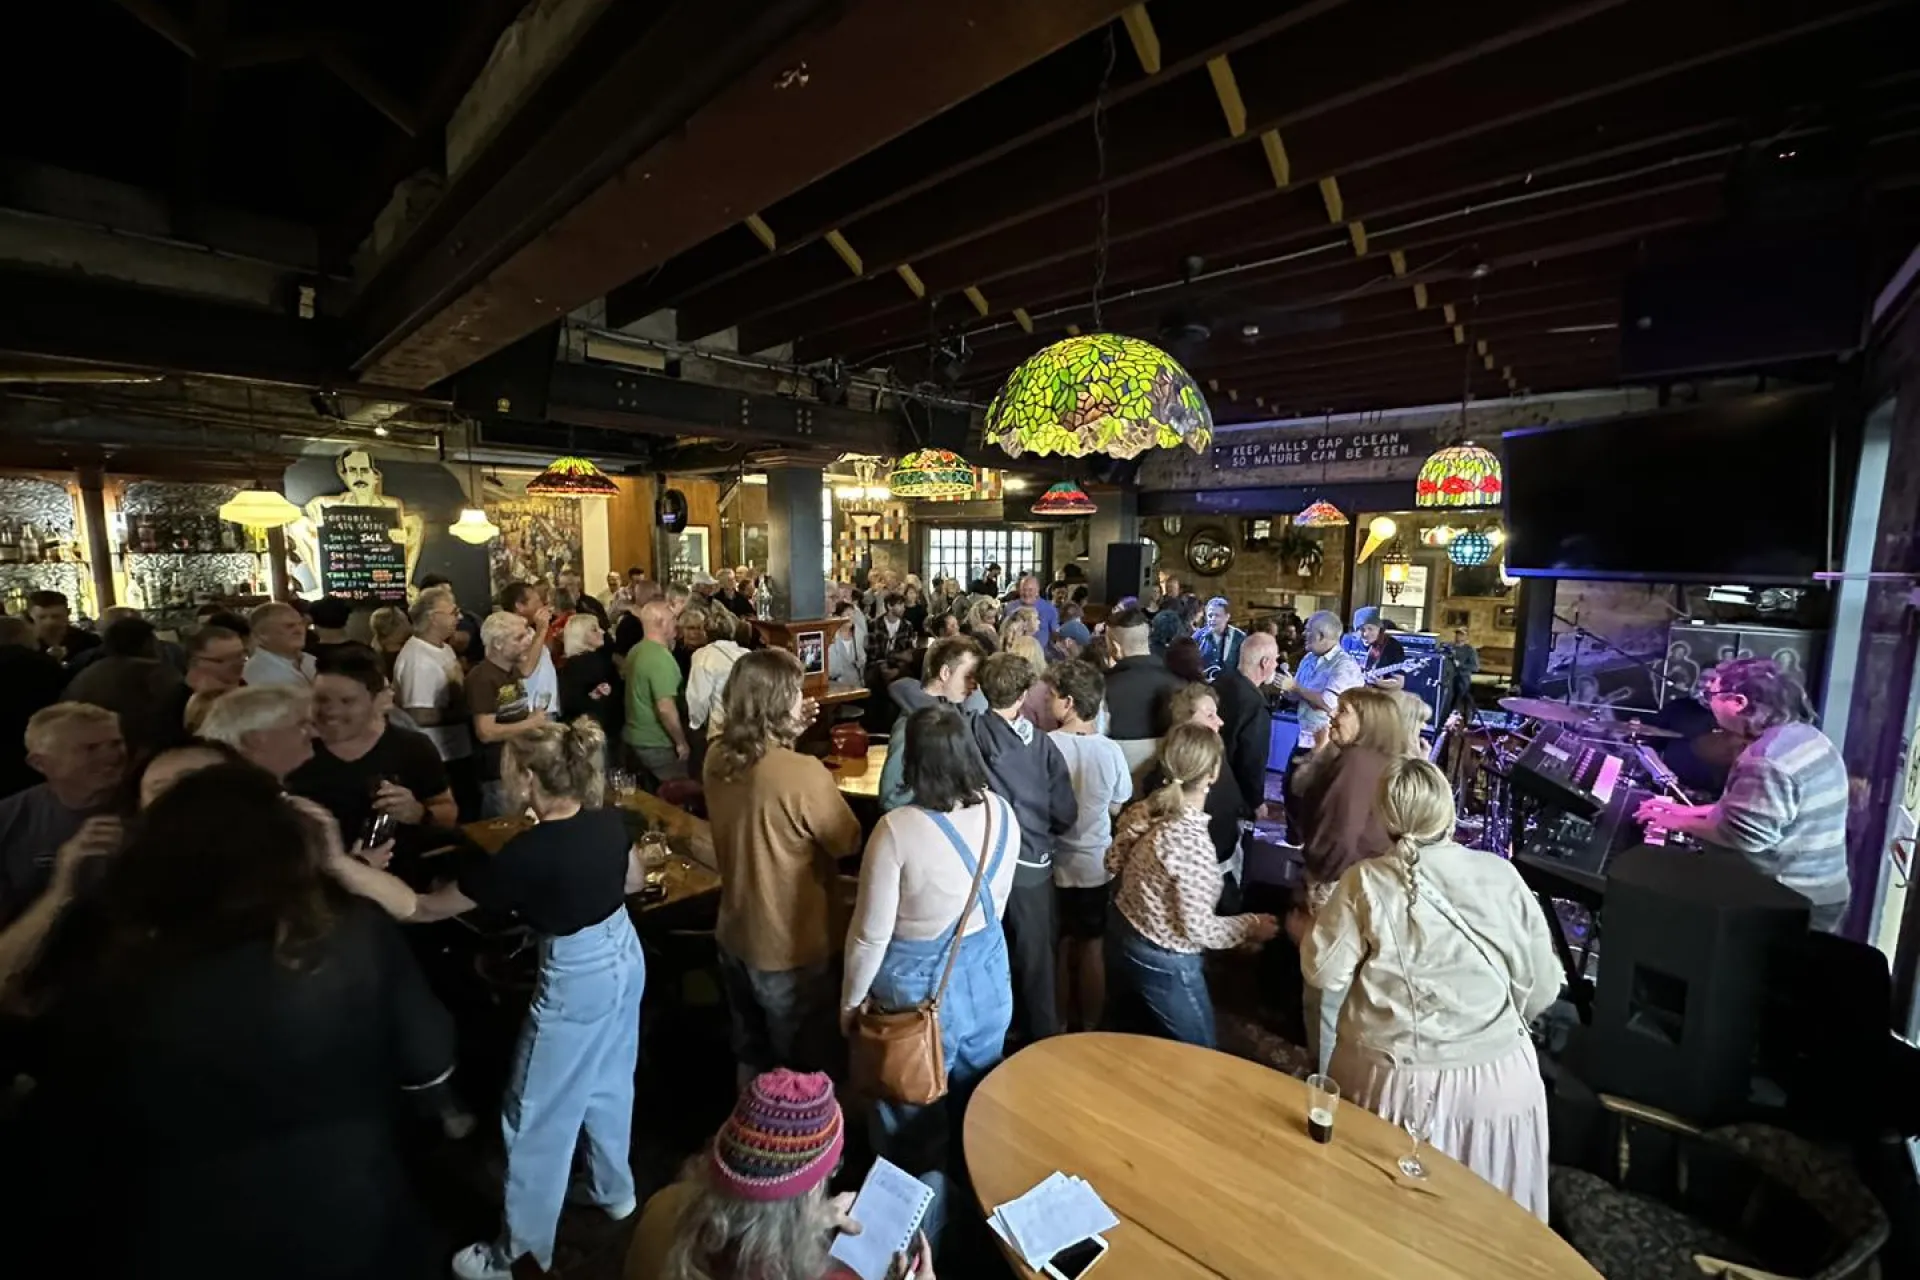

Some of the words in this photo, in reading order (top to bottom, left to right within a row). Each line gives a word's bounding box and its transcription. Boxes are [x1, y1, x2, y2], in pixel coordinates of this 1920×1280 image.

[1232, 444, 1261, 457] KEEP
[1268, 440, 1309, 453] HALLS
[1317, 437, 1343, 450] GAP
[1353, 432, 1400, 447] CLEAN
[1232, 455, 1247, 467] SO
[1254, 451, 1301, 466] NATURE
[1311, 449, 1337, 462] CAN
[1345, 447, 1362, 460] BE
[1373, 443, 1409, 457] SEEN
